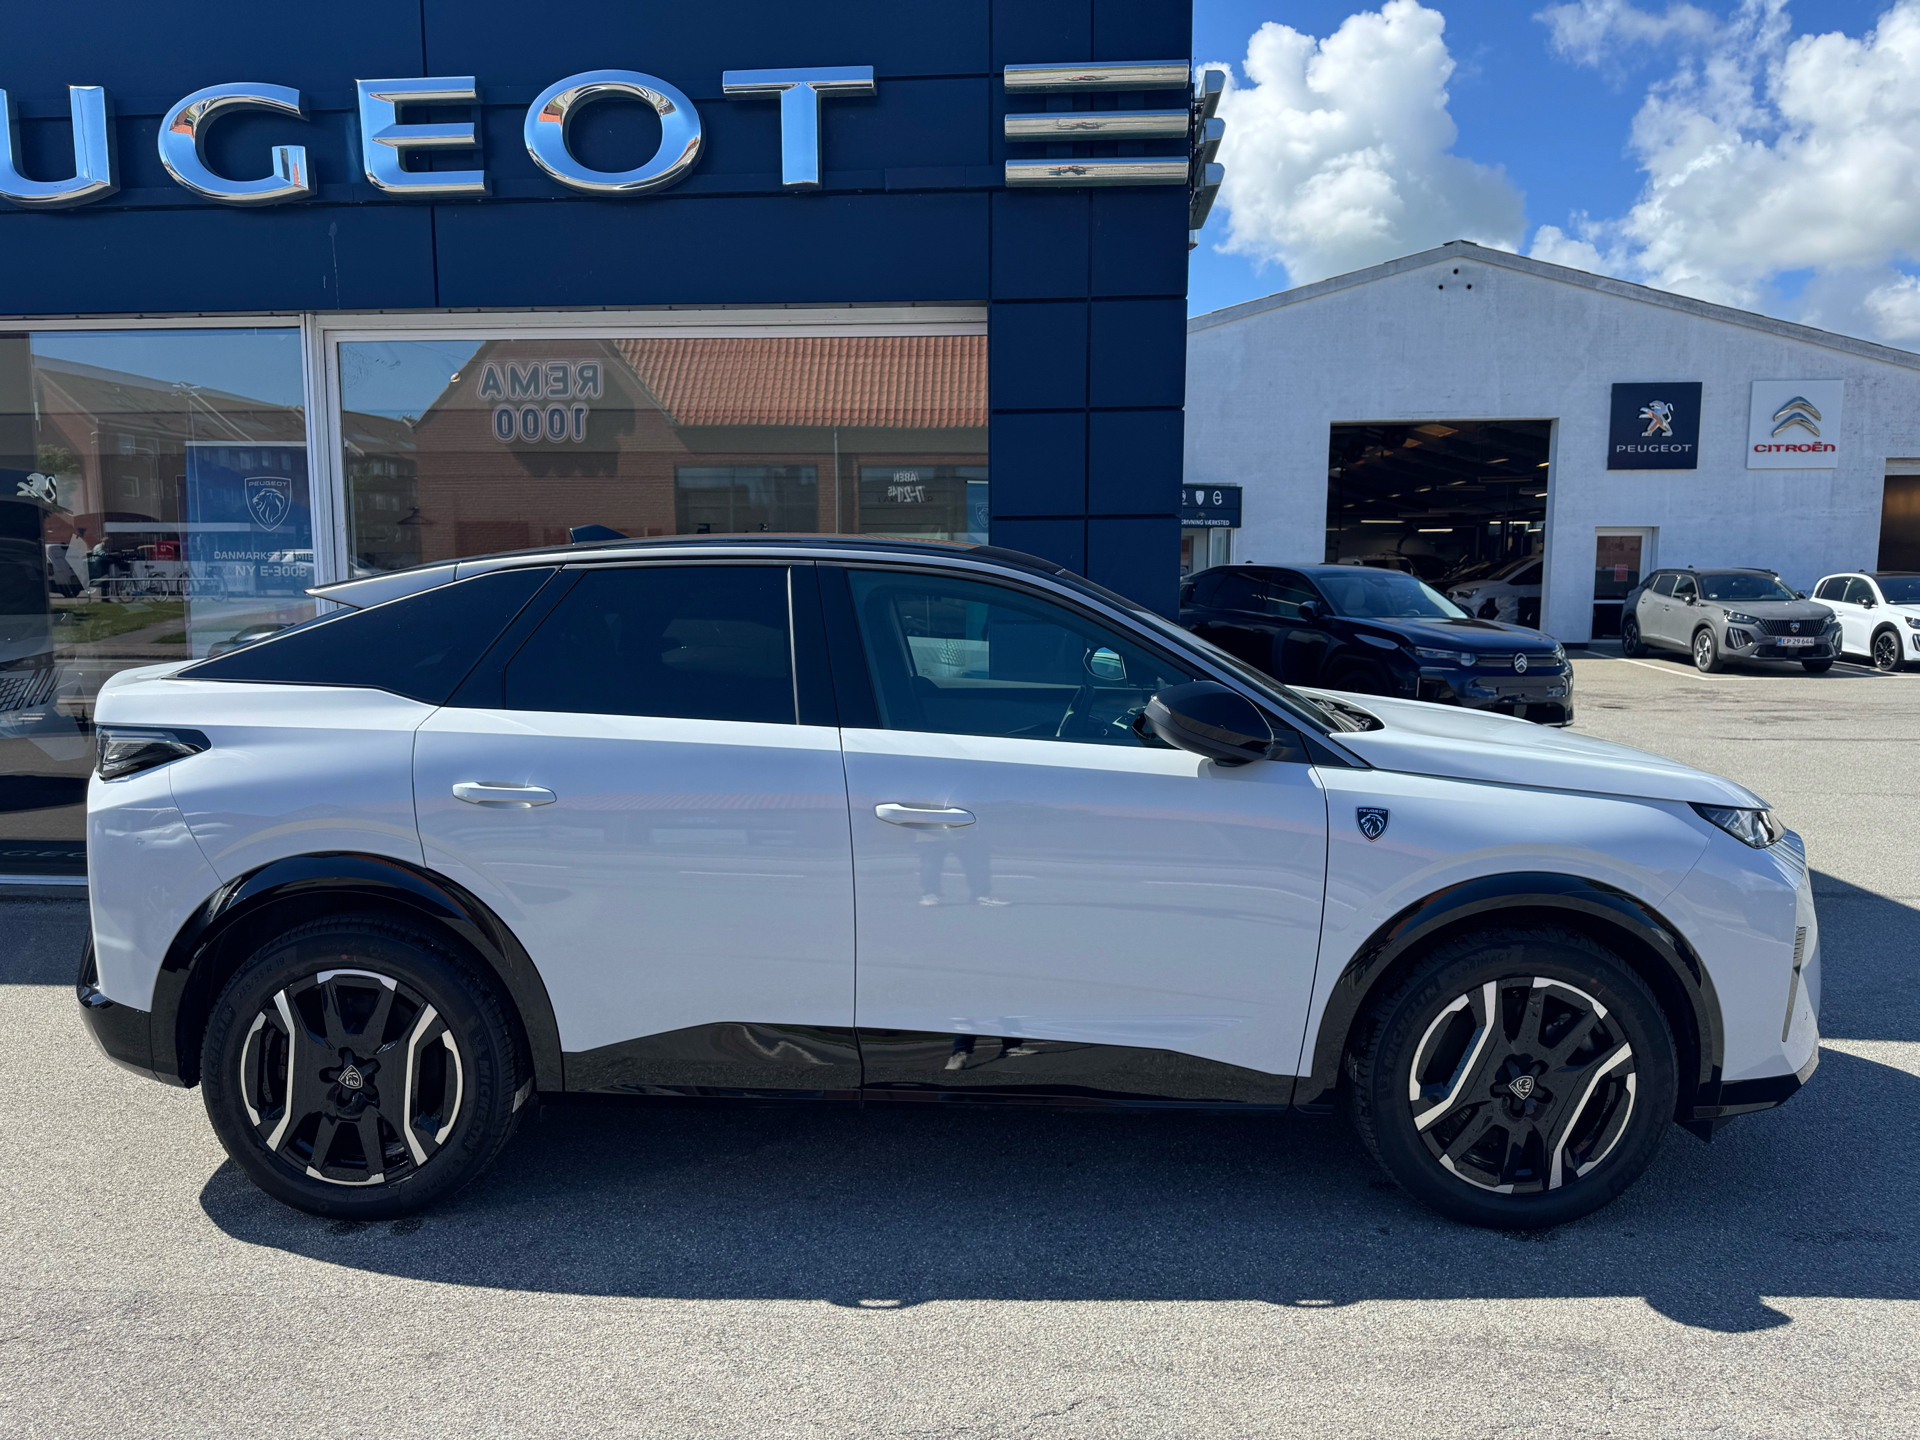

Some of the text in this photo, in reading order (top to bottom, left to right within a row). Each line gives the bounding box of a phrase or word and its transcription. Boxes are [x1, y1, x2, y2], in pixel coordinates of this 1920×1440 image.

[1615, 444, 1692, 453] PEUGEOT
[235, 565, 307, 577] NY E-3008
